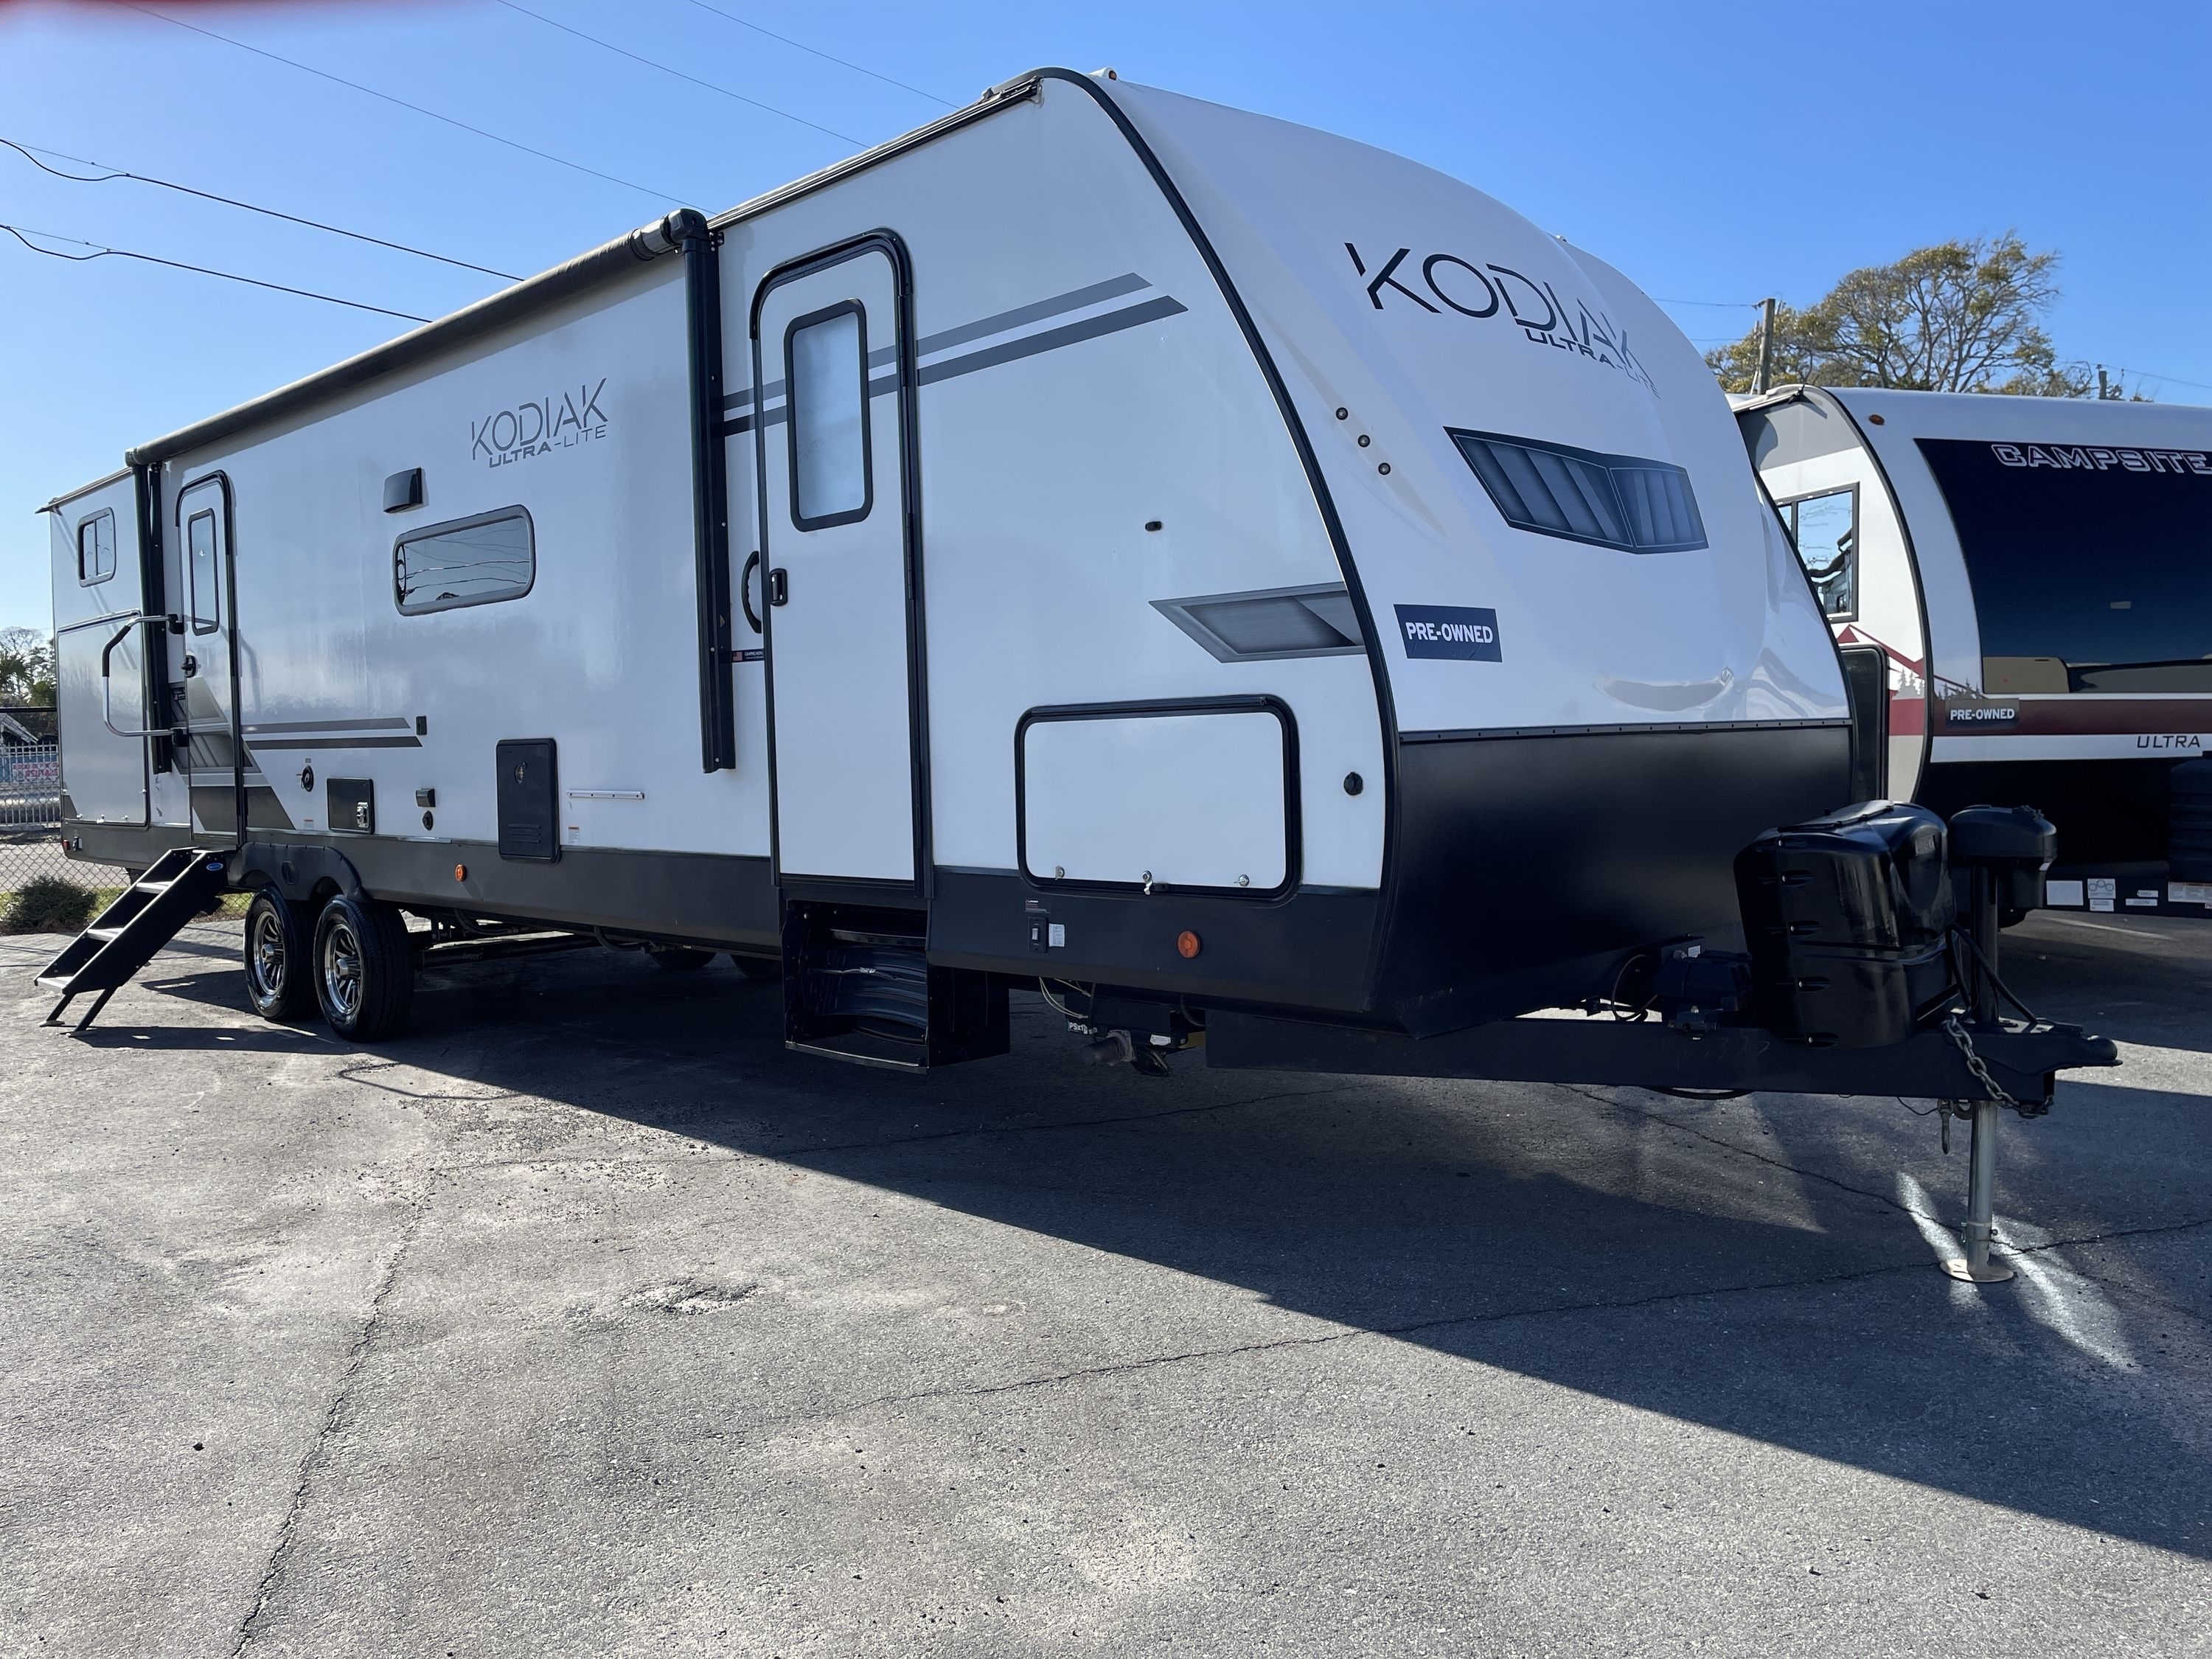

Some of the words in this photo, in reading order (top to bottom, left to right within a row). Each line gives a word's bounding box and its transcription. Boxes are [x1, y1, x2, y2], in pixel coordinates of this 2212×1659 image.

[1344, 242, 1656, 386] KODIAK
[1525, 328, 1661, 400] ULTRA-LITE
[471, 378, 608, 460] KODIAK
[490, 425, 607, 468] ULTRA-LITE
[1991, 445, 2212, 474] CAMPSITE
[1405, 622, 1494, 644] PRE-OWNED
[1950, 709, 2015, 720] PRE-OWNED
[2137, 735, 2200, 748] ULTRA
